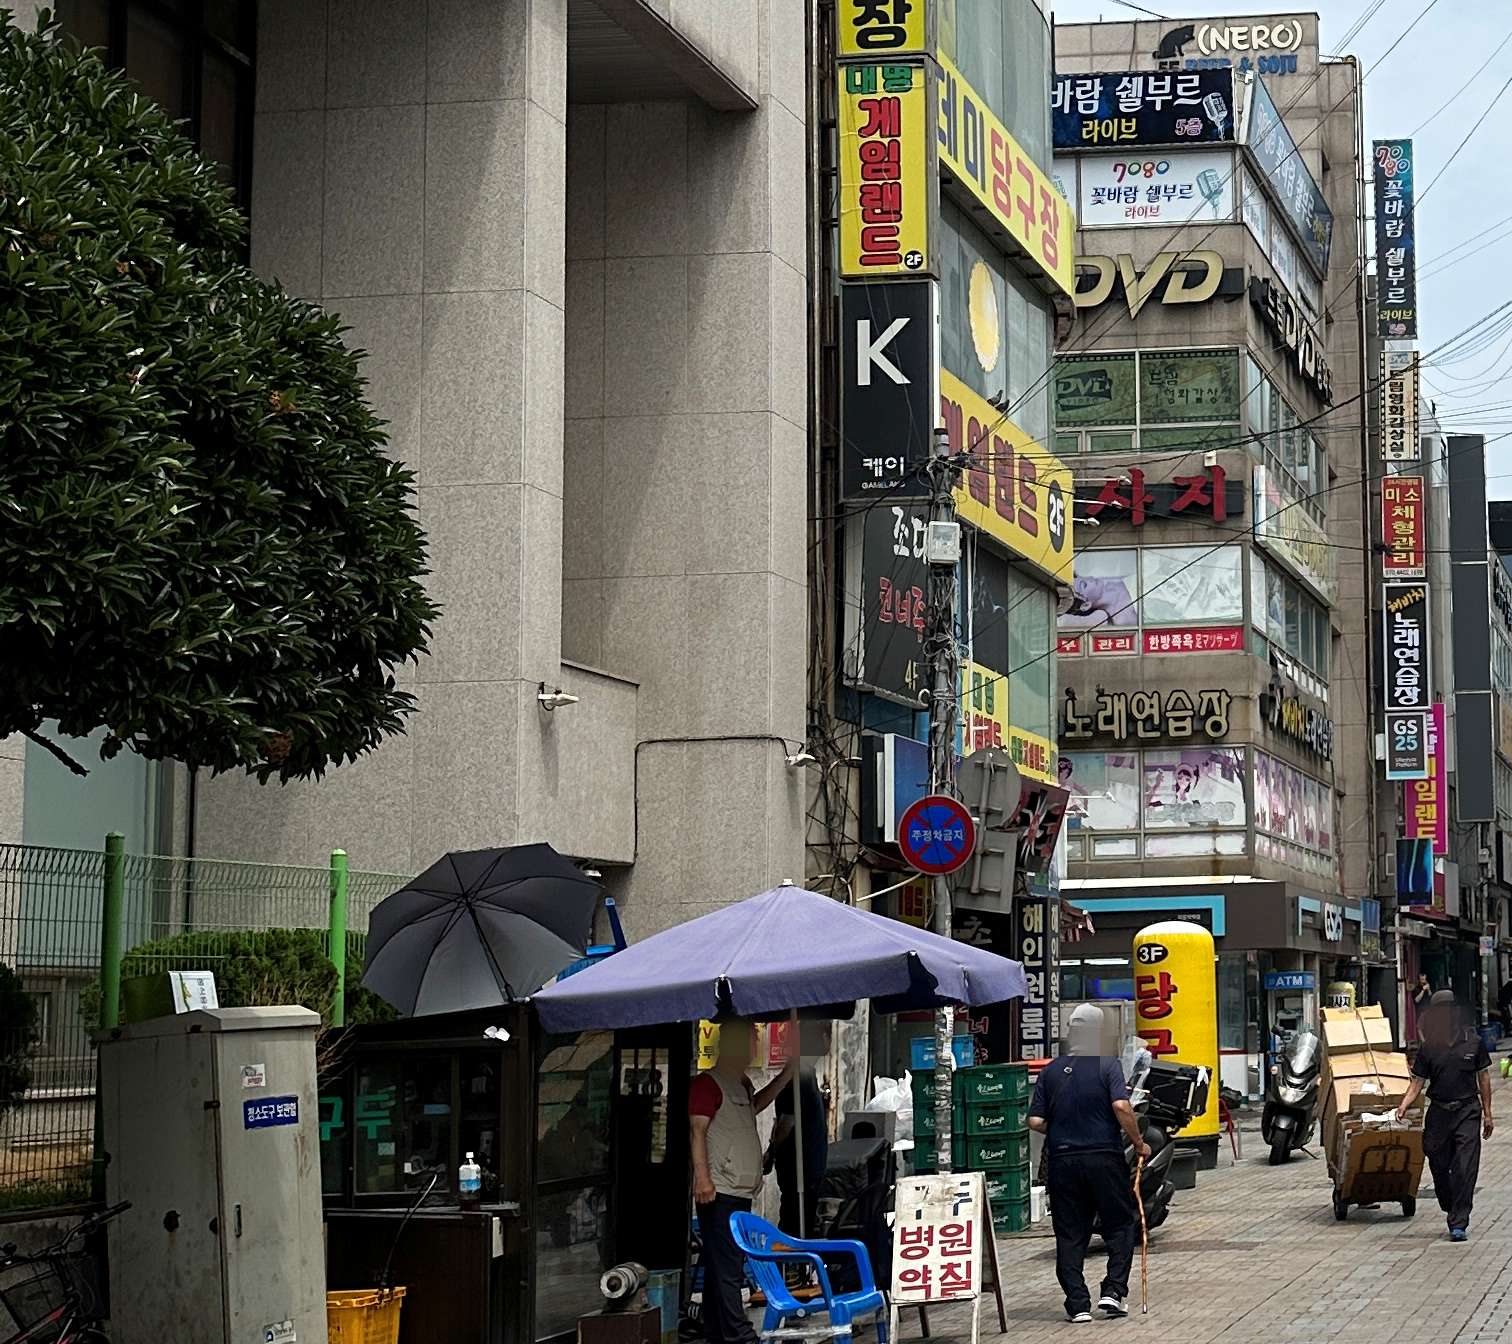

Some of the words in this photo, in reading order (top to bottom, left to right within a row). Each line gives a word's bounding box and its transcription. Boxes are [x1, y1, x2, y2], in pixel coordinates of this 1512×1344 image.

[1198, 19, 1303, 56] (NERO)
[1115, 74, 1203, 113] 쉘부르
[1082, 117, 1139, 143] 라이브
[857, 96, 904, 267] 게임랜드
[1112, 160, 1170, 183] 7080
[990, 126, 1060, 272] 당구장
[1090, 186, 1139, 204] 꽃바람
[1146, 183, 1194, 203] 쉘부르
[1125, 206, 1161, 219] 라이브
[1384, 179, 1405, 238] 꽃바람
[904, 253, 923, 266] 2F
[1384, 247, 1407, 304] 쉘부르
[1071, 249, 1225, 320] DVD
[857, 317, 912, 386] K
[1385, 488, 1421, 502] 미소
[1049, 492, 1066, 537] 2F
[1391, 506, 1417, 565] 체형관리
[1097, 638, 1131, 651] 관리
[1393, 612, 1422, 706] 노래연습장
[1063, 688, 1231, 740] 노래연습장
[1394, 720, 1419, 736] GS
[1395, 736, 1419, 752] 25
[911, 828, 965, 843] 주정차금지
[1138, 947, 1164, 962] 3F
[1275, 975, 1304, 987] ATM
[899, 1220, 973, 1261] 병원
[899, 1261, 973, 1300] 약칠
